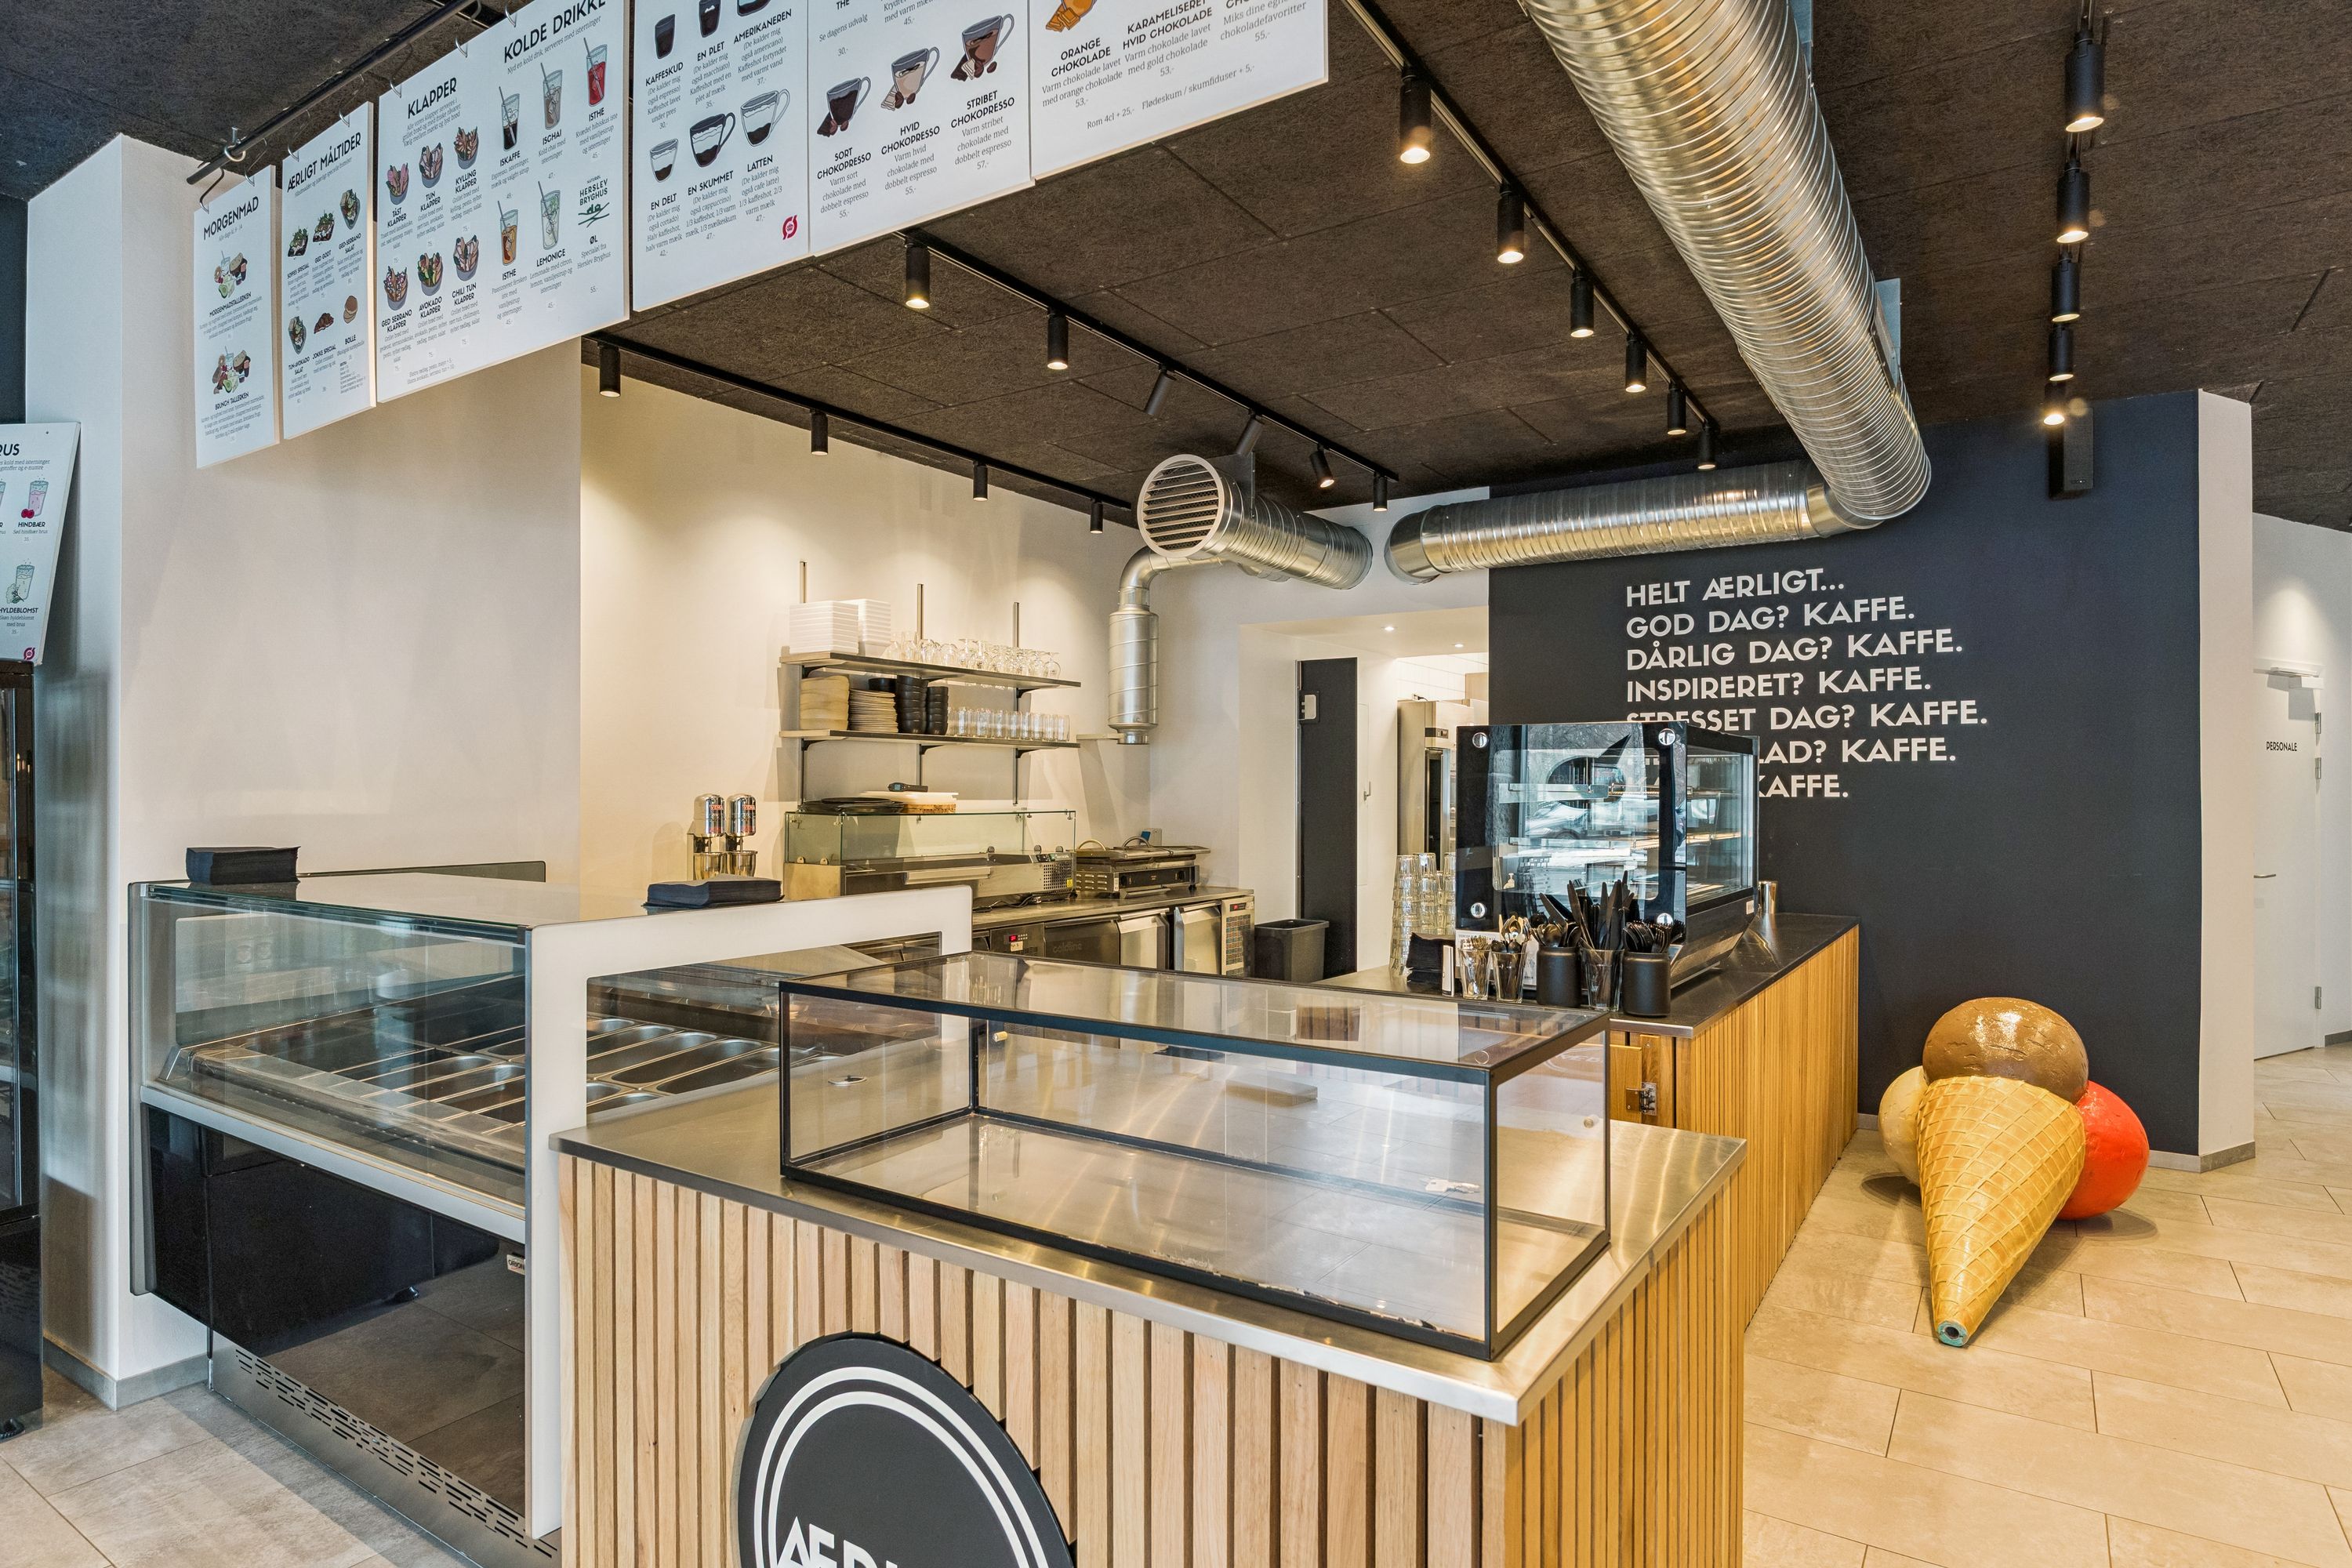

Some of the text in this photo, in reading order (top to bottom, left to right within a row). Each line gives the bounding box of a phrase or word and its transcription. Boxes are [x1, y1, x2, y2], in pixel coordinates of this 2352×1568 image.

[837, 0, 849, 9] THE
[884, 10, 898, 23] med
[899, 4, 915, 16] varm
[1224, 12, 1243, 25] Miks
[1246, 4, 1265, 16] dine
[1268, 0, 1287, 9] egn
[733, 9, 792, 44] AMERIKANEREN
[827, 24, 848, 38] dagens
[848, 14, 868, 28] udvalg
[904, 16, 915, 25] 45,-
[1123, 7, 1212, 49] HVID CHOKOLADE
[1221, 2, 1306, 40] chokoladefavoritter
[504, 23, 547, 63] KOLDE
[1124, 24, 1210, 63] Varm chokolade lavet
[1255, 31, 1270, 42] 55,-
[697, 42, 724, 61] EN PLET
[837, 47, 848, 56] 30,-
[1061, 38, 1101, 60] ORANGE
[1127, 40, 1208, 75] med gold chokolade
[1051, 47, 1111, 77] CHOKOLADE
[1160, 66, 1174, 77] 53,-
[645, 62, 684, 86] KAFFESKUD
[1042, 58, 1121, 94] Varm chokolade lavet
[408, 77, 456, 119] KLAPPER
[1042, 71, 1123, 107] med orange chokolade
[967, 90, 997, 110] STRIBET
[1075, 98, 1088, 107] 53,-
[1087, 118, 1103, 129] Rom
[1105, 113, 1115, 122] 4cl
[1122, 107, 1135, 118] 25,-
[1142, 89, 1182, 110] Flødeskum
[1189, 71, 1237, 93] skumfiduser
[589, 107, 604, 122] ISTHE
[951, 97, 1014, 128] CHOKOPRESSO
[900, 122, 920, 136] HVID
[962, 116, 1004, 137] Varm stribet
[543, 129, 562, 145] ISCHAI
[881, 126, 940, 154] CHOKOPRESSO
[957, 125, 1009, 152] chokolade med
[499, 151, 521, 167] ISKAFFE
[834, 147, 853, 162] SORT
[894, 144, 927, 162] Varm hvid
[955, 140, 1012, 165] dobbelt espresso
[287, 160, 317, 193] ÆRLIGT
[321, 132, 361, 170] MÅLTIDER
[747, 154, 773, 172] LATTEN
[817, 152, 872, 180] CHOKOPRESSO
[887, 154, 935, 177] chokolade med
[977, 160, 989, 170] 57,-
[456, 169, 477, 185] KYLLING
[688, 170, 734, 195] EN SKUMMET
[751, 171, 768, 183] kalder
[768, 165, 779, 176] mig
[829, 171, 858, 187] Varm sort
[884, 166, 937, 191] dobbelt espresso
[456, 177, 477, 194] KLAPPER
[579, 178, 608, 198] HERSLEV
[741, 186, 754, 197] også
[766, 176, 779, 187] latte)
[822, 179, 866, 201] chokolade med
[905, 187, 916, 195] 55,-
[420, 197, 441, 212] KLAPPER
[426, 191, 435, 201] TUN
[579, 187, 608, 205] BRYGHUS
[651, 193, 677, 210] EN DELT
[820, 191, 869, 213] dobbelt espresso
[204, 196, 259, 240] MORGENMAD
[387, 213, 406, 228] KLAPPER
[839, 209, 850, 219] 55,-
[590, 235, 597, 244] ØL
[536, 249, 566, 267] LEMONICE
[502, 269, 516, 281] ISTHE
[452, 282, 477, 298] CHILI TUN
[454, 292, 474, 306] KLAPPER
[419, 296, 442, 311] AVOKADO
[420, 305, 441, 318] KLAPPER
[381, 310, 412, 327] GED SERRANO
[387, 320, 406, 332] KLAPPER
[345, 335, 356, 344] BOLLE
[0, 444, 20, 456] US
[1627, 568, 1844, 607] HELT ÆRLIGT...
[1626, 596, 1915, 638] GOD DAG? KAFFE.
[1627, 629, 1962, 670] DÅRLIG DAG? KAFFE.
[1627, 666, 1931, 702] INSPIRERET? KAFFE.
[1770, 705, 1855, 730] DAG?
[1871, 700, 1987, 727] KAFFE.
[1759, 738, 1955, 764] AD? KAFFE.
[2266, 742, 2297, 751] PERSONALE
[1053, 942, 1082, 953] coldline
